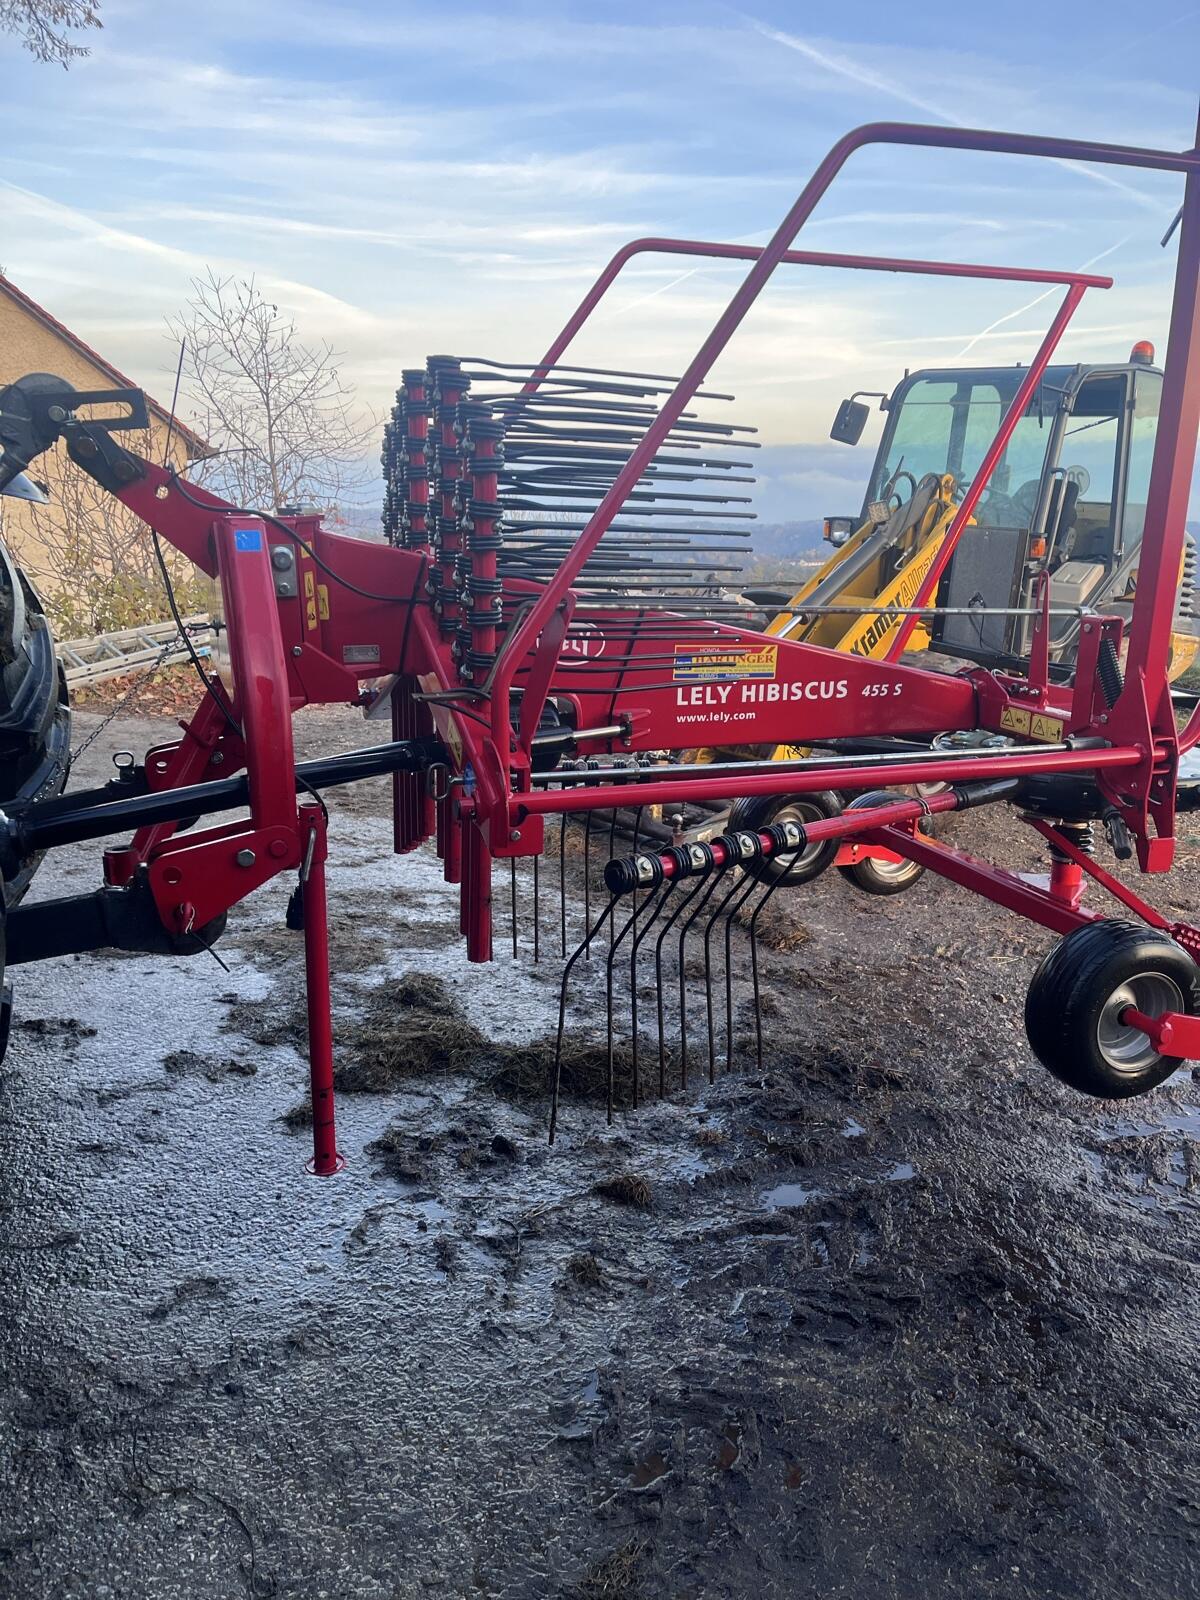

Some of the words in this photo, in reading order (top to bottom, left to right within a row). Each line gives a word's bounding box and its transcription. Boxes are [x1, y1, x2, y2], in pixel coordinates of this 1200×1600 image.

[676, 685, 732, 706] LELY
[741, 680, 848, 703] HIBISCUS
[862, 684, 889, 697] 455
[893, 683, 903, 696] S
[676, 711, 756, 723] www.lely.com
